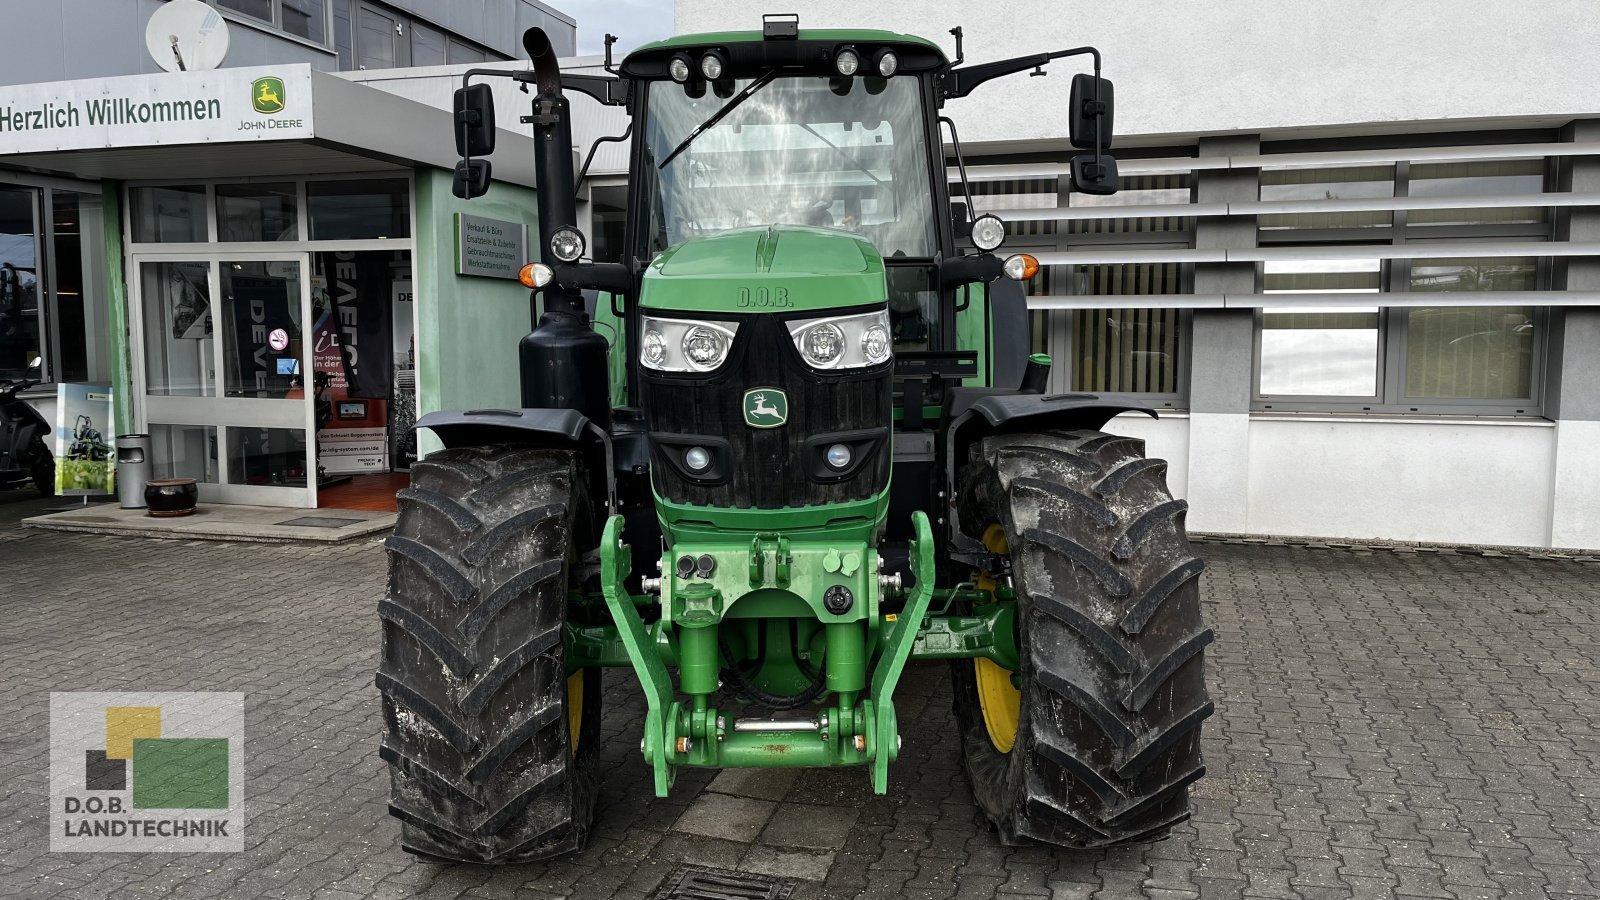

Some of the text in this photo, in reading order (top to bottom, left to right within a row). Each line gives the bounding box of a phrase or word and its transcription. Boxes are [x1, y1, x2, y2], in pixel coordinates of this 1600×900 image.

[0, 98, 222, 132] Herzlich Willkommen
[238, 119, 302, 130] JOHN DEERE
[466, 222, 502, 236] Verkauf & Büro
[492, 238, 496, 246] &
[736, 286, 794, 308] D.O.B.
